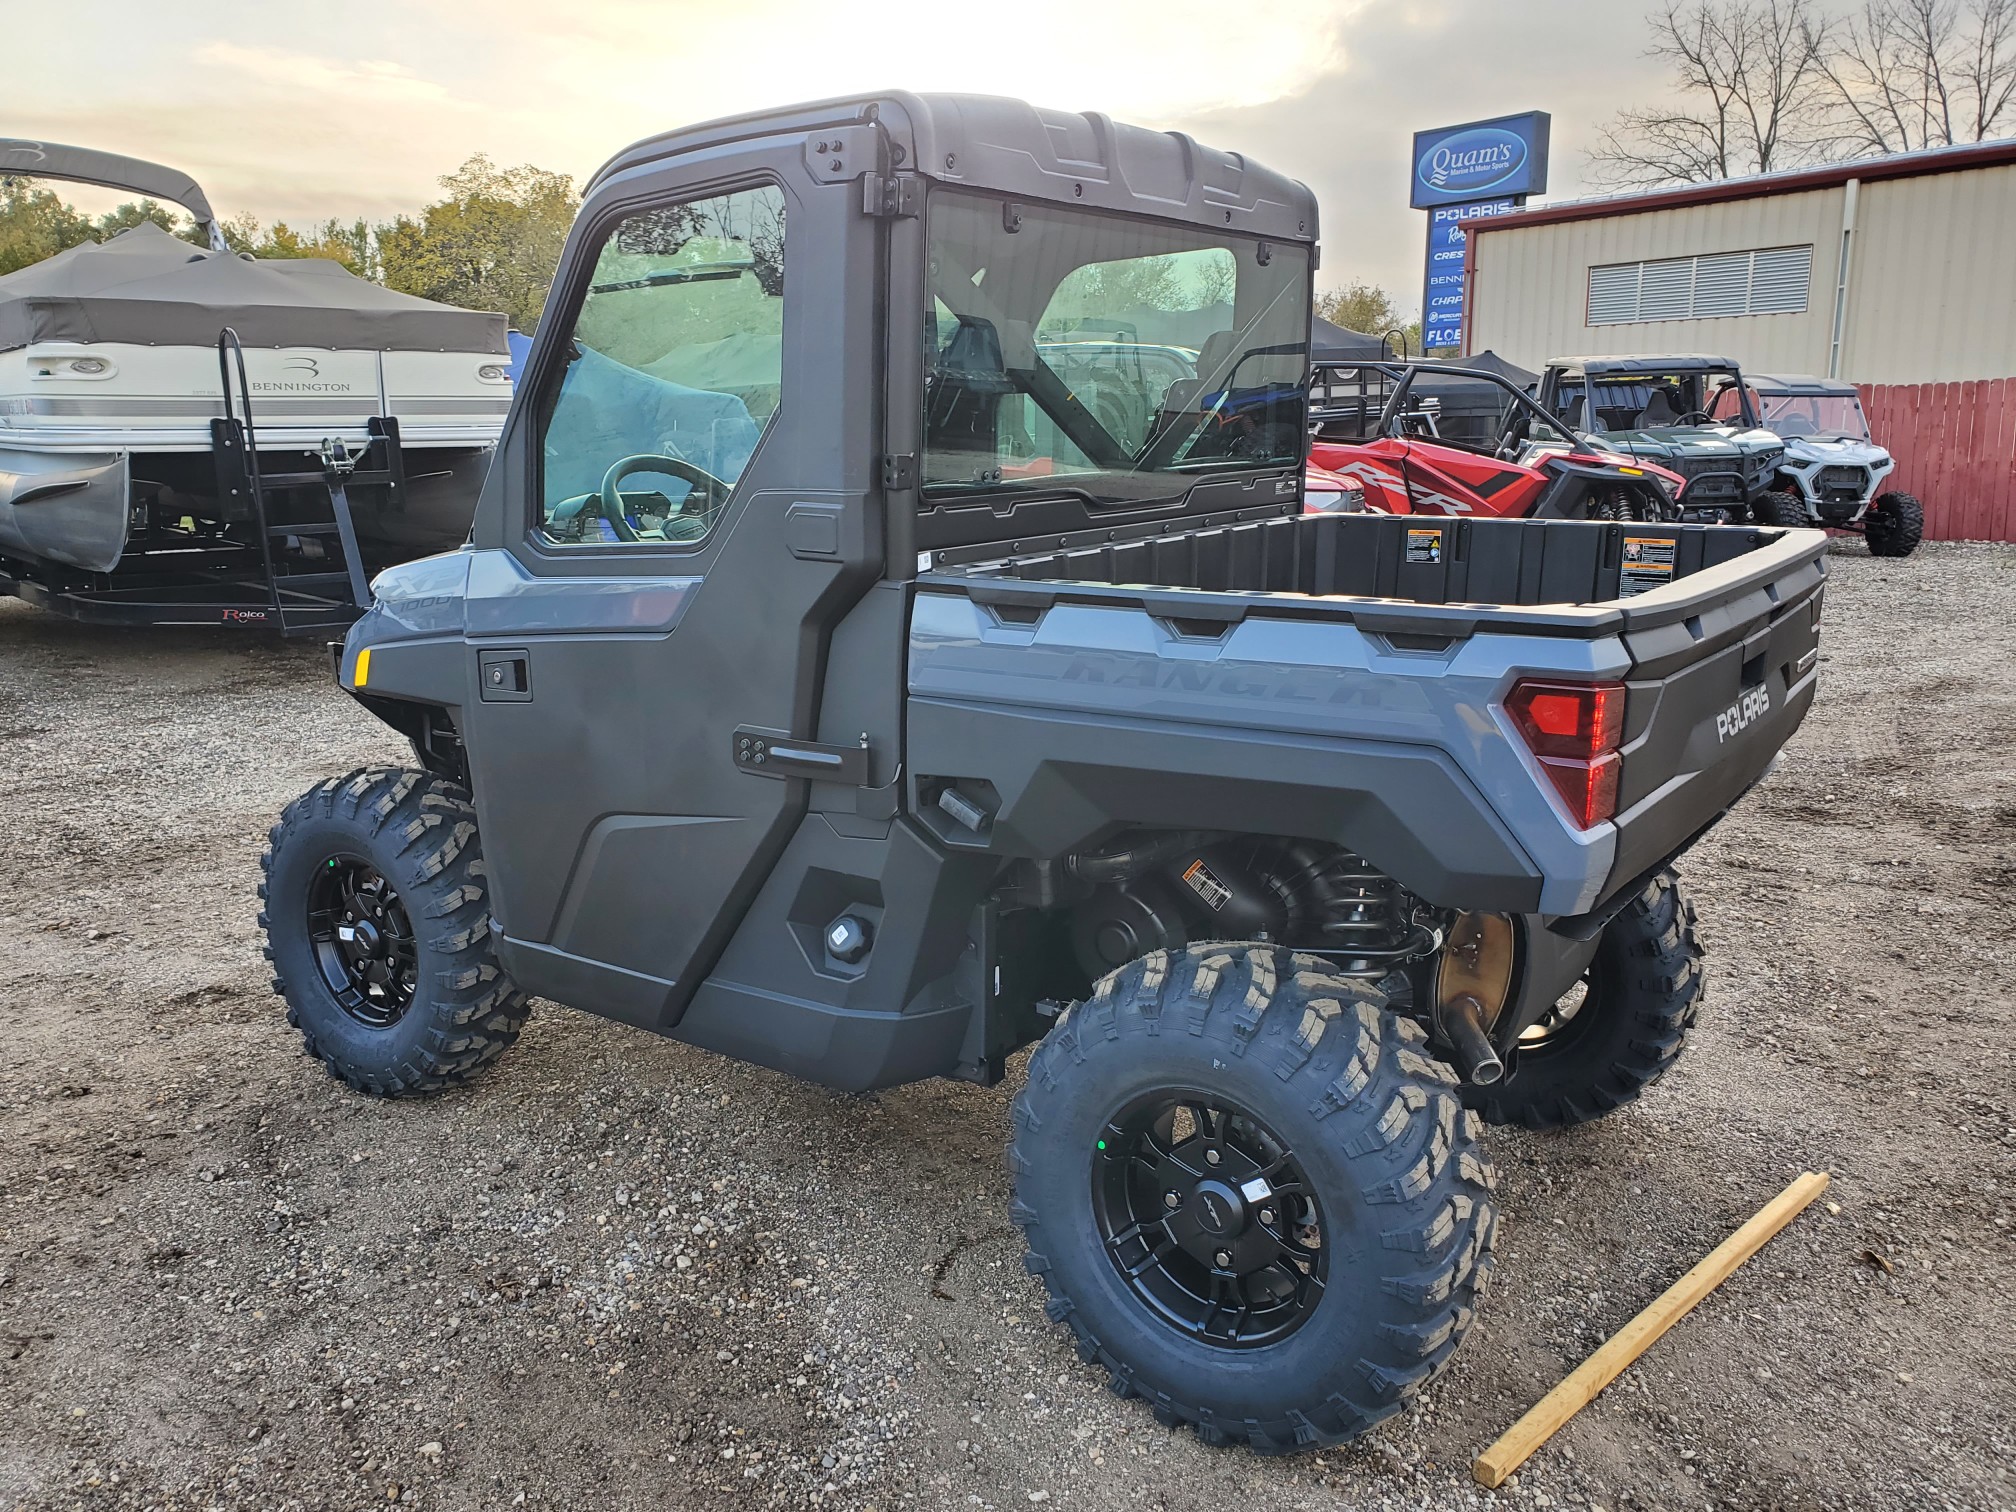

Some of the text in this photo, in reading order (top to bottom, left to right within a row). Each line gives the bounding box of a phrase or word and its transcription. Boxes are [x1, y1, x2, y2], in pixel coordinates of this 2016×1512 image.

[1432, 143, 1512, 175] Quam's
[1450, 167, 1469, 176] Marine
[1475, 164, 1491, 172] Motor
[1491, 161, 1510, 171] Sports
[1434, 202, 1510, 223] POLARIS
[1426, 328, 1462, 342] FLOE
[252, 382, 350, 392] BENNINGTON
[1334, 461, 1473, 516] RZR
[222, 609, 266, 621] Rolco
[1061, 651, 1397, 706] RANGER
[1716, 683, 1770, 743] POLARIS
